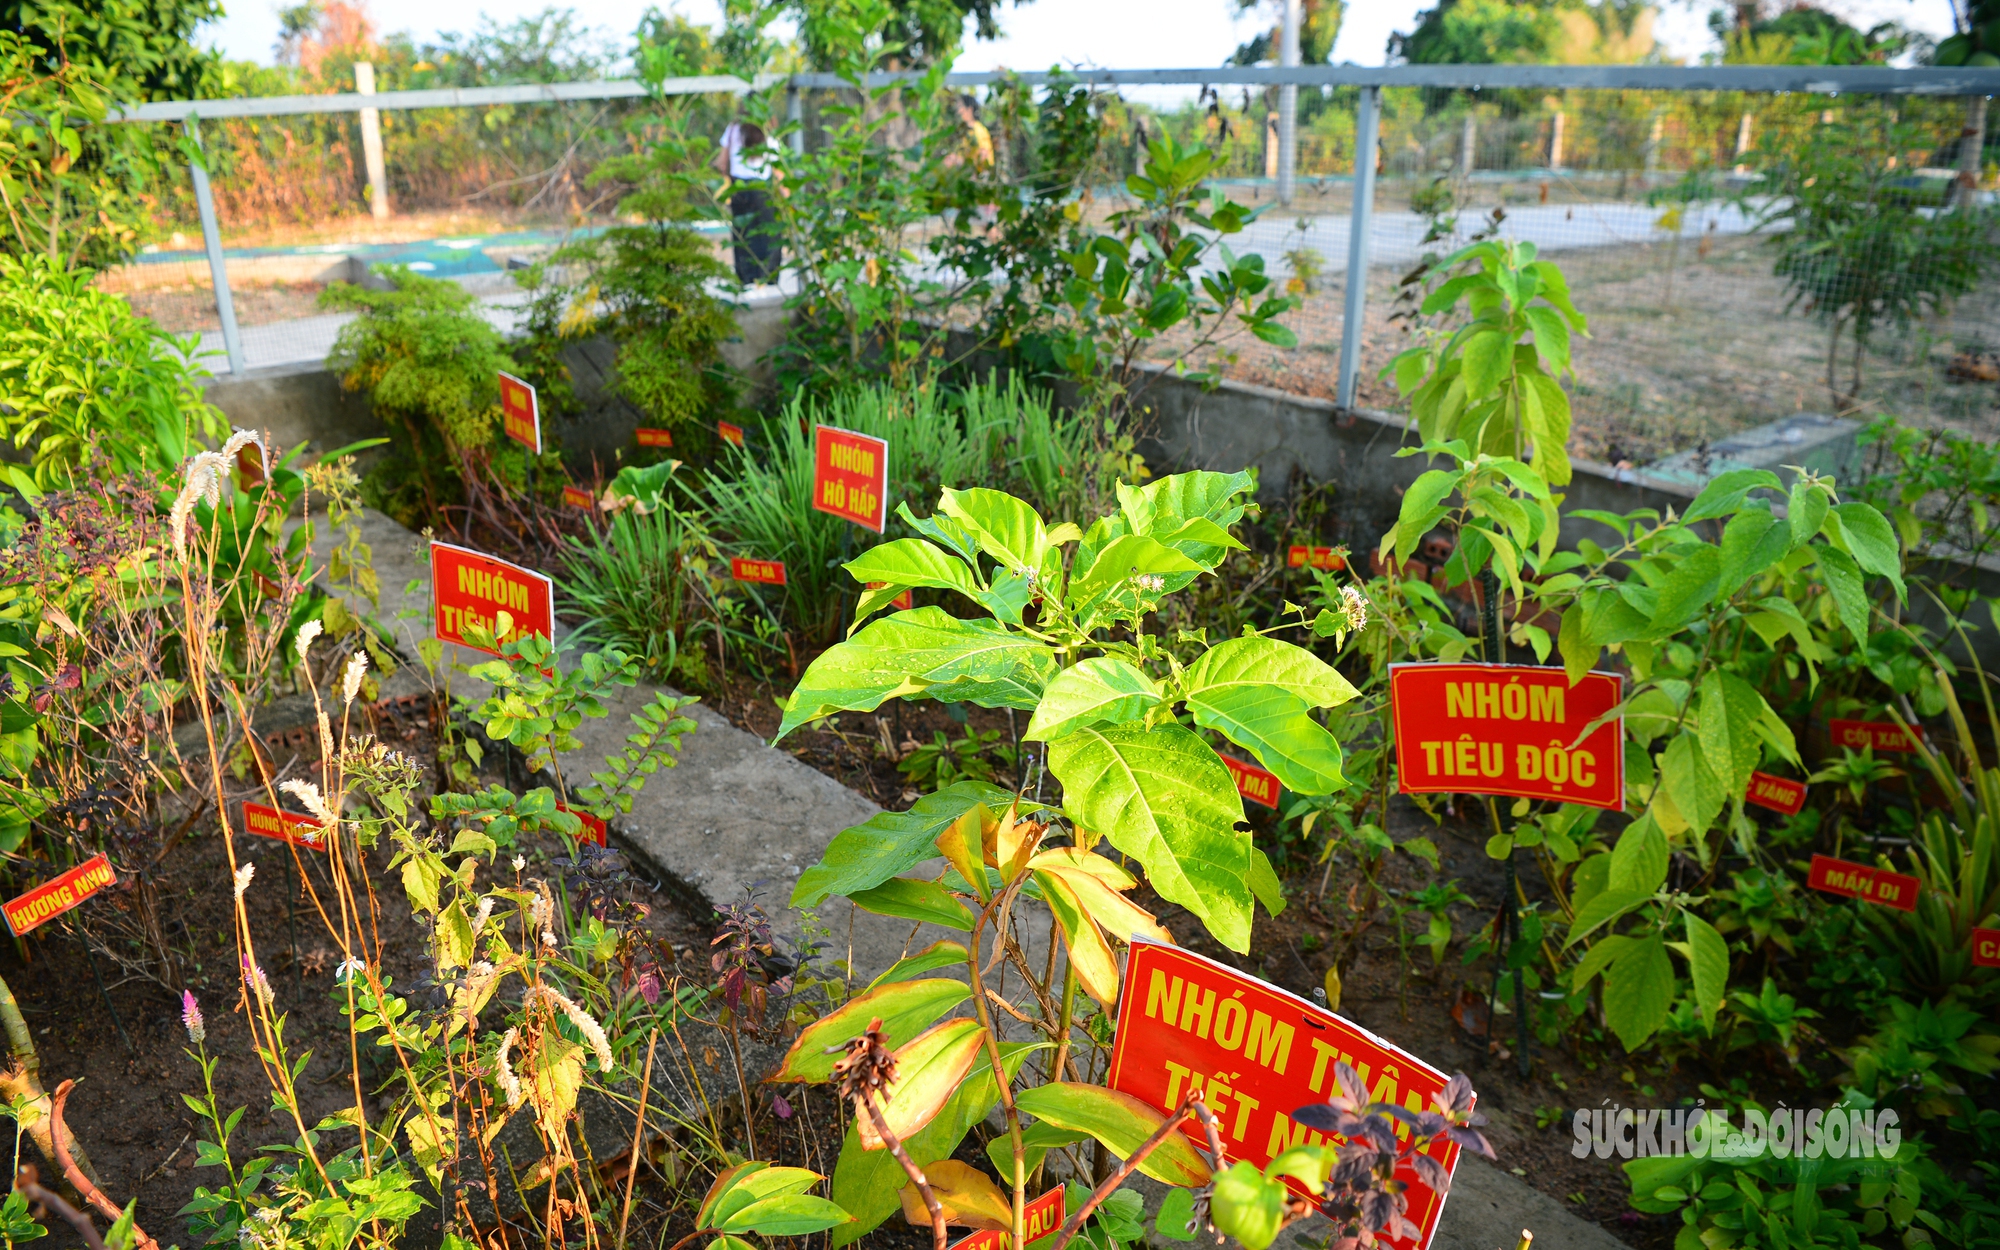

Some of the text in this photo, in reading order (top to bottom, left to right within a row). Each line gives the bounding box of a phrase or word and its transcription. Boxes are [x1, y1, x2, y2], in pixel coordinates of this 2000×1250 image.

[830, 442, 874, 478] NHÓM
[823, 478, 877, 519] HÔ HẤP
[458, 564, 529, 614] NHÓM
[1445, 675, 1566, 724] NHÓM
[1420, 733, 1596, 792] TIÊU ĐỘC
[1243, 774, 1269, 800] MÁ
[11, 885, 75, 930] HƯƠNG
[1877, 881, 1901, 901] DI
[1144, 967, 1296, 1075] NHÓM
[1164, 1059, 1260, 1143] TIẾT
